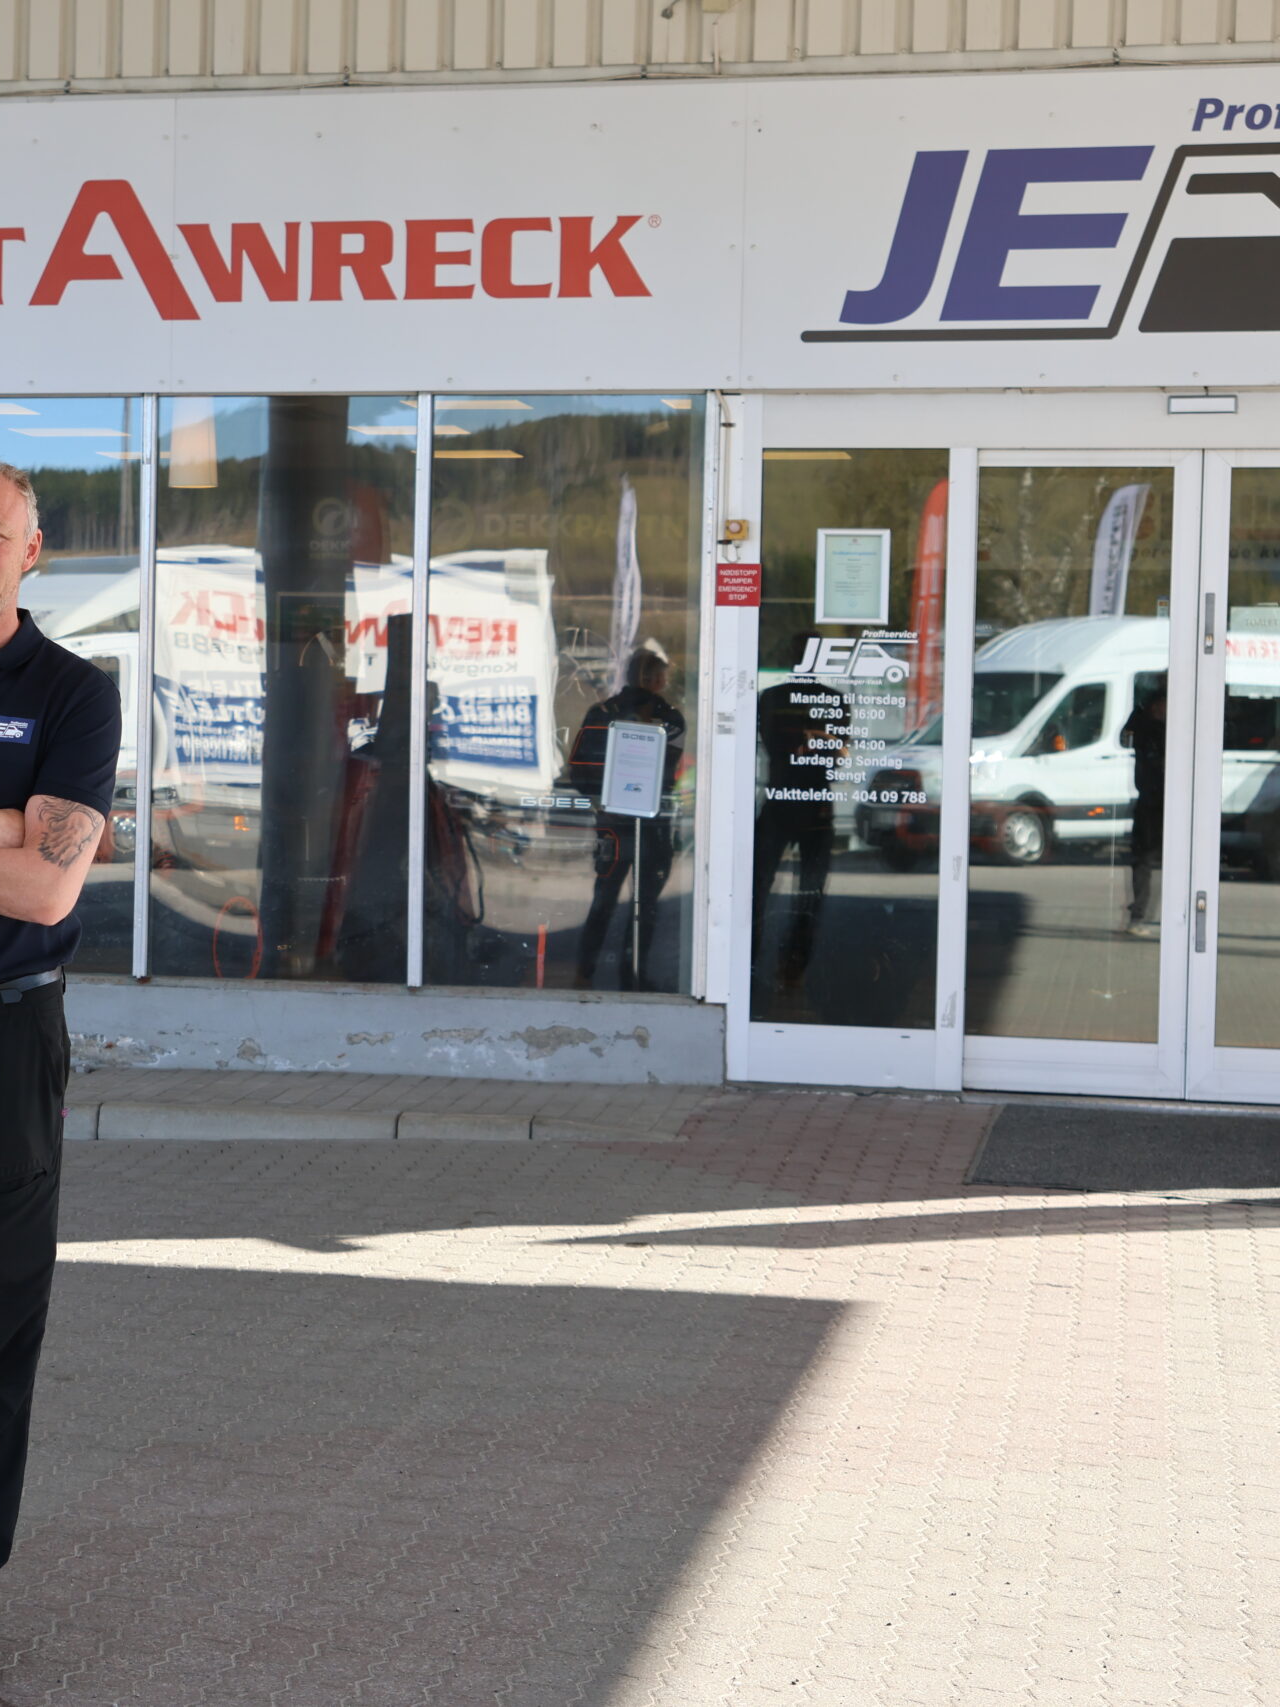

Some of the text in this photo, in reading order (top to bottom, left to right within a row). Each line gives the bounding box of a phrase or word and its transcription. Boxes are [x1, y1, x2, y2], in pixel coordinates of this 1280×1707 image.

[839, 145, 1155, 325] JE
[728, 593, 748, 601] STOP
[862, 630, 918, 639] Proffservice
[793, 637, 857, 674] JE
[790, 692, 907, 708] Mandag til torsdag
[809, 708, 843, 720] 07:30
[853, 709, 886, 720] 16:00
[825, 724, 869, 738] Fredag
[808, 739, 843, 750] 08:00
[853, 740, 886, 750] 14:00
[790, 754, 903, 769] Lørdag og Søndag
[825, 770, 866, 783] Stengt
[765, 787, 927, 804] Vakttelefon: 404 09 788
[520, 796, 592, 809] GOES
